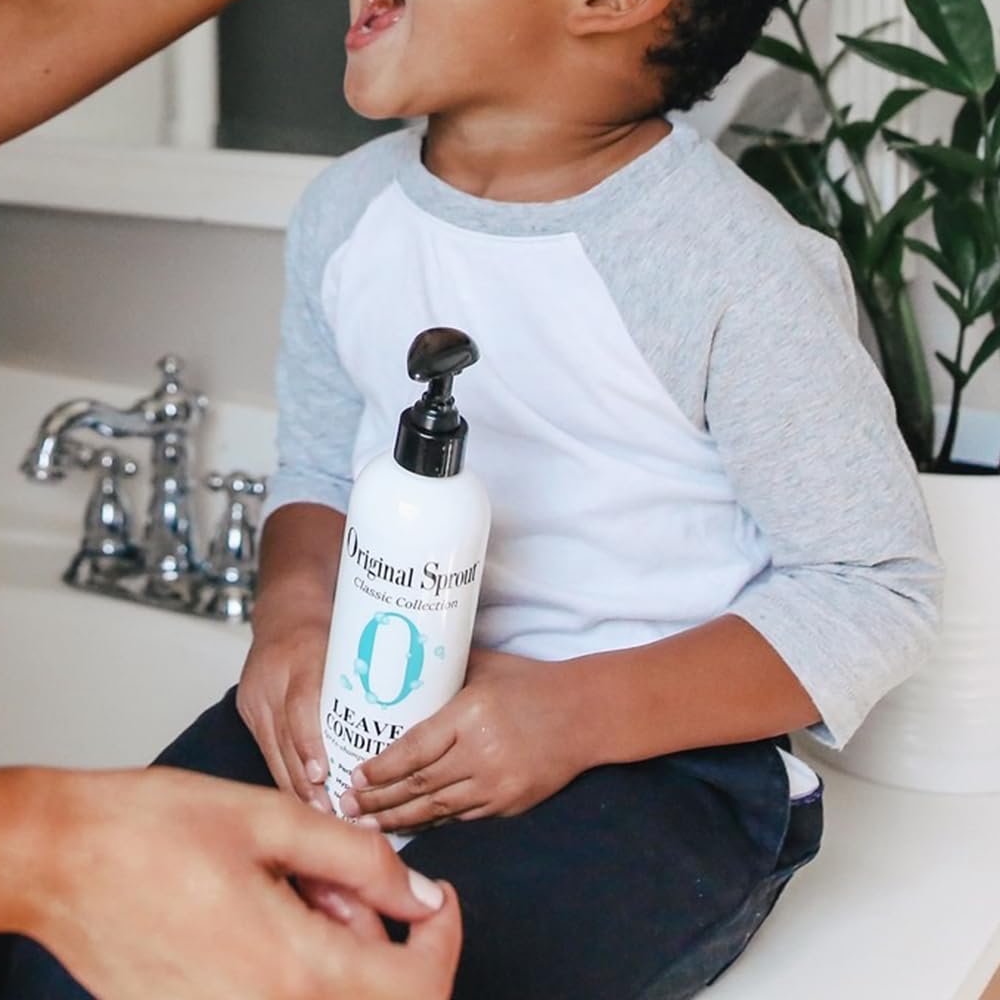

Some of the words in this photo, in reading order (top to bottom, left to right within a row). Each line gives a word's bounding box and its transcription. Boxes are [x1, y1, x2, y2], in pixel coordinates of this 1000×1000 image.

[347, 526, 414, 588] Original
[420, 561, 478, 596] Sprout
[353, 576, 392, 604] Classic
[395, 597, 458, 611] Collection
[326, 713, 391, 756] CONDIT
